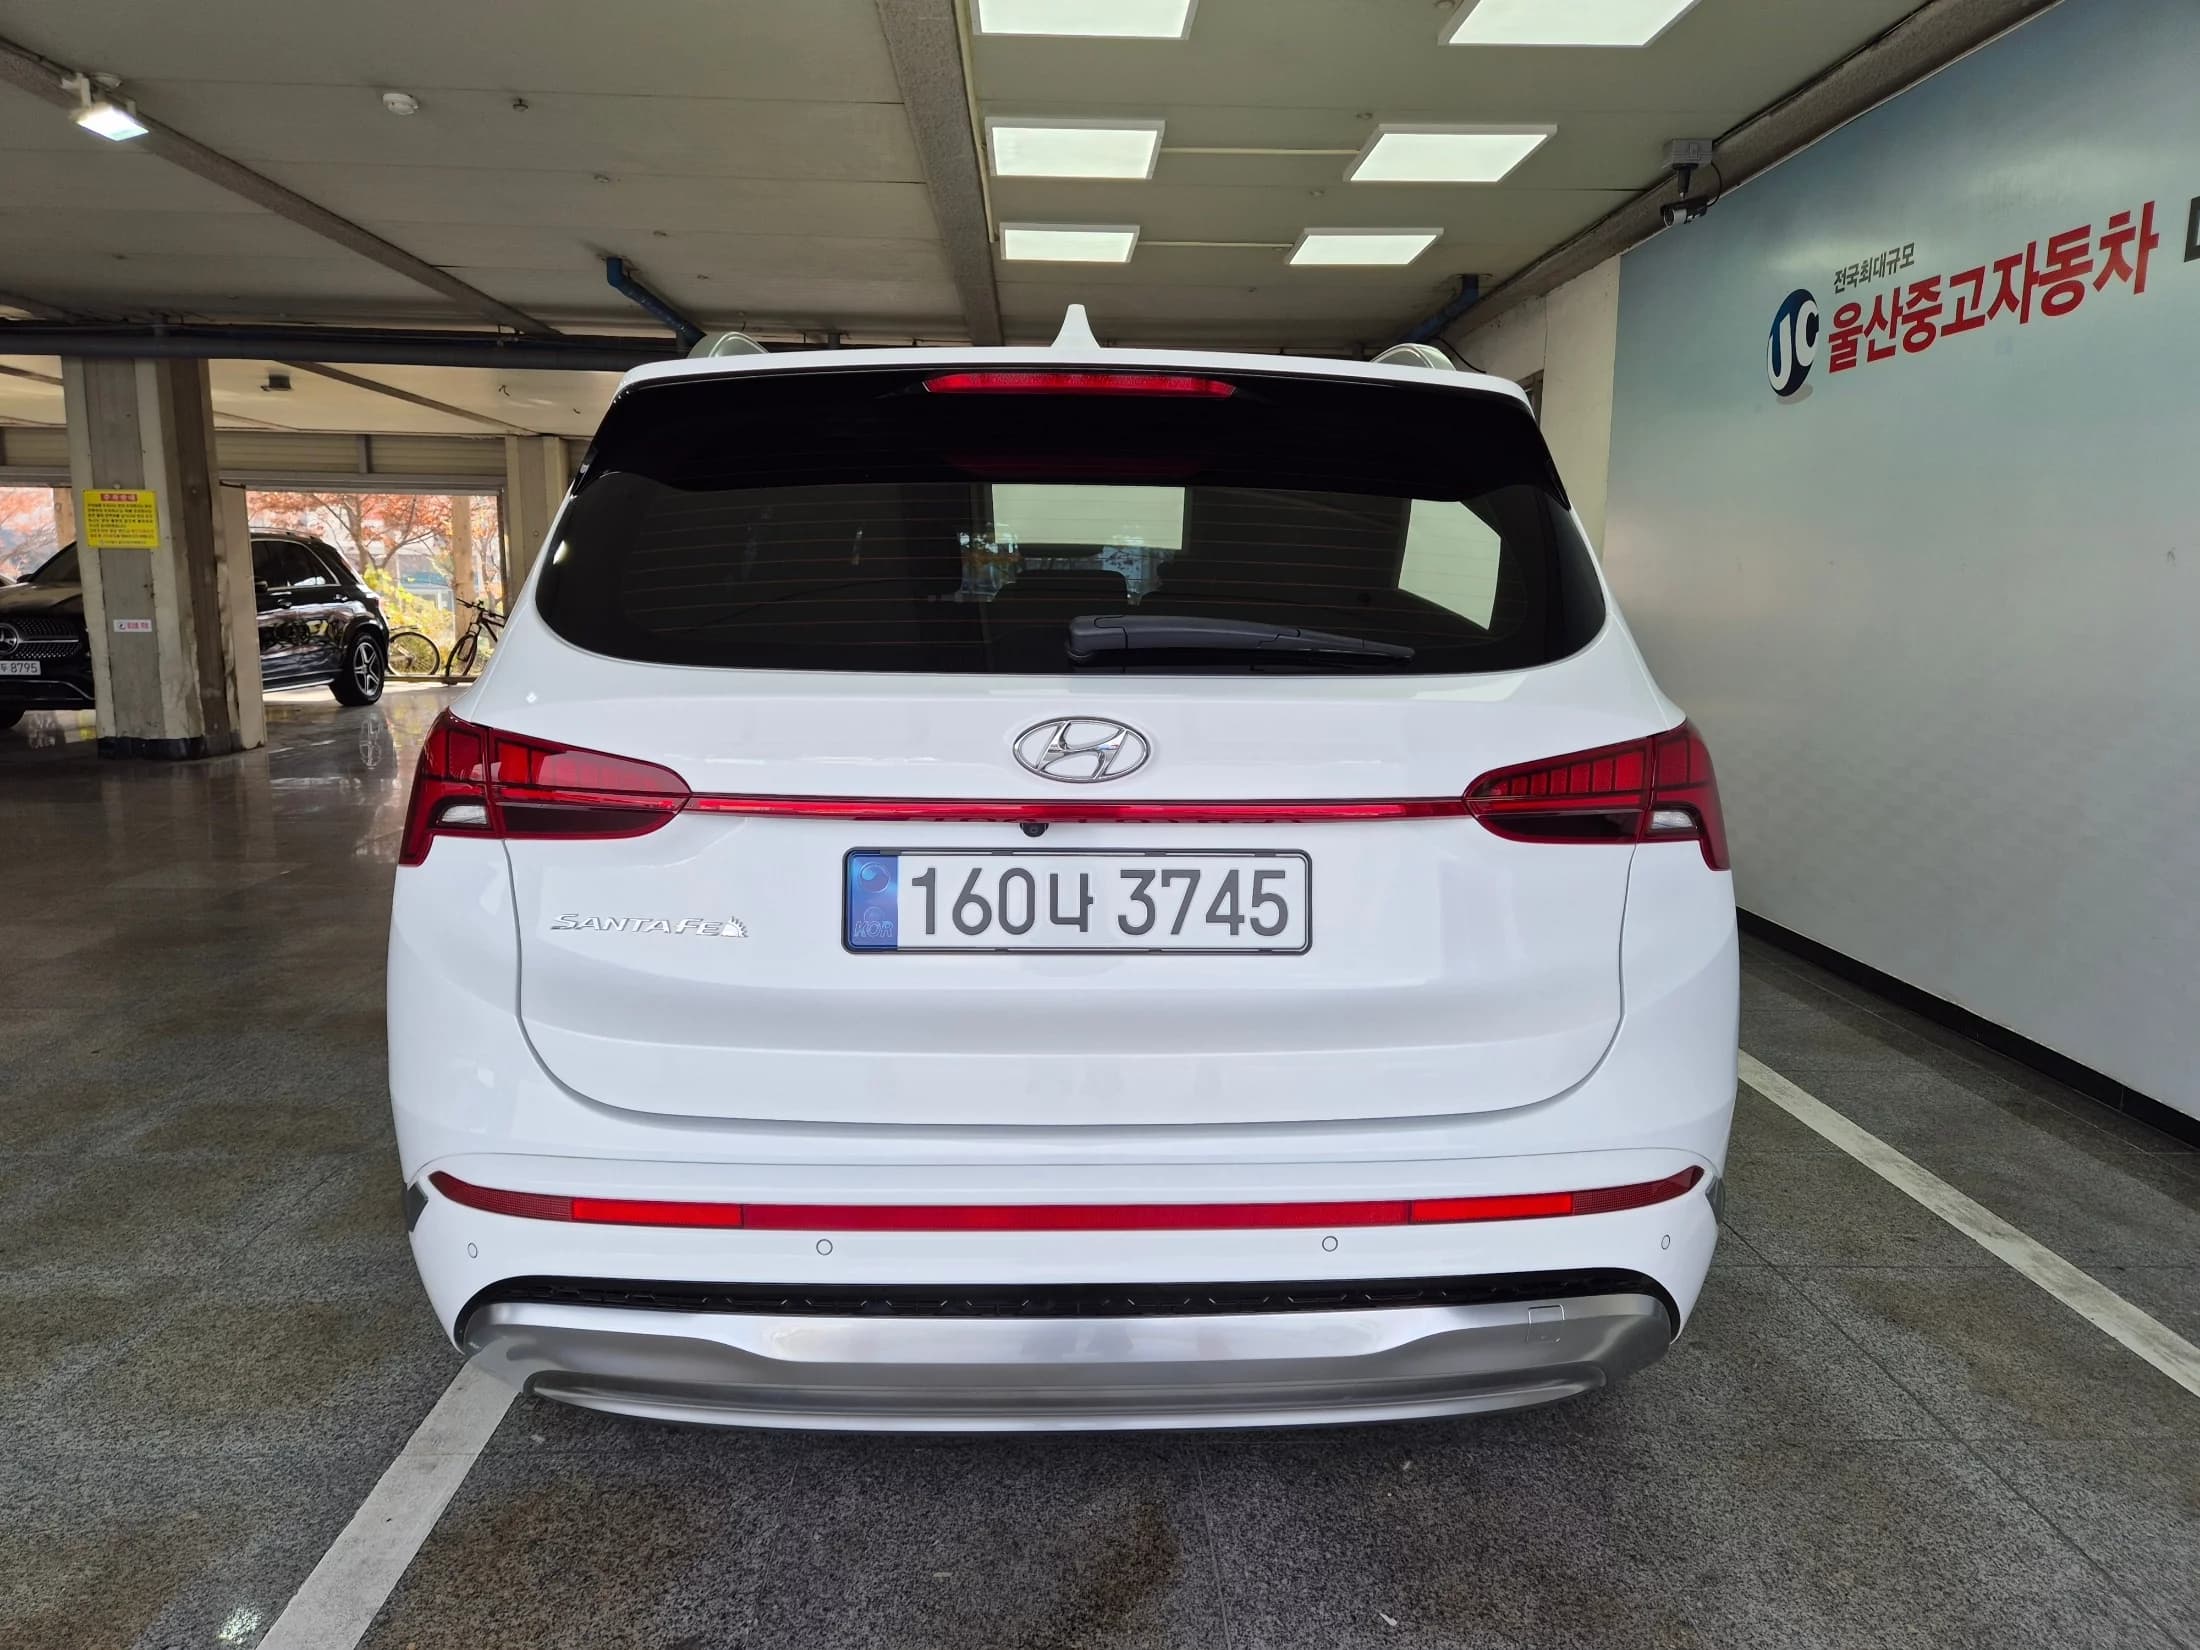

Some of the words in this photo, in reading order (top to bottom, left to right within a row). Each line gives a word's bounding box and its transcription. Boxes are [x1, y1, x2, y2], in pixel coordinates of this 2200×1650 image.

[1828, 200, 2160, 374] 울산중고자동차
[1834, 242, 1915, 294] 전국최대규모
[10, 662, 38, 674] 8795
[911, 867, 1094, 936] 160나
[1117, 868, 1289, 937] 3745
[854, 920, 894, 938] KOR
